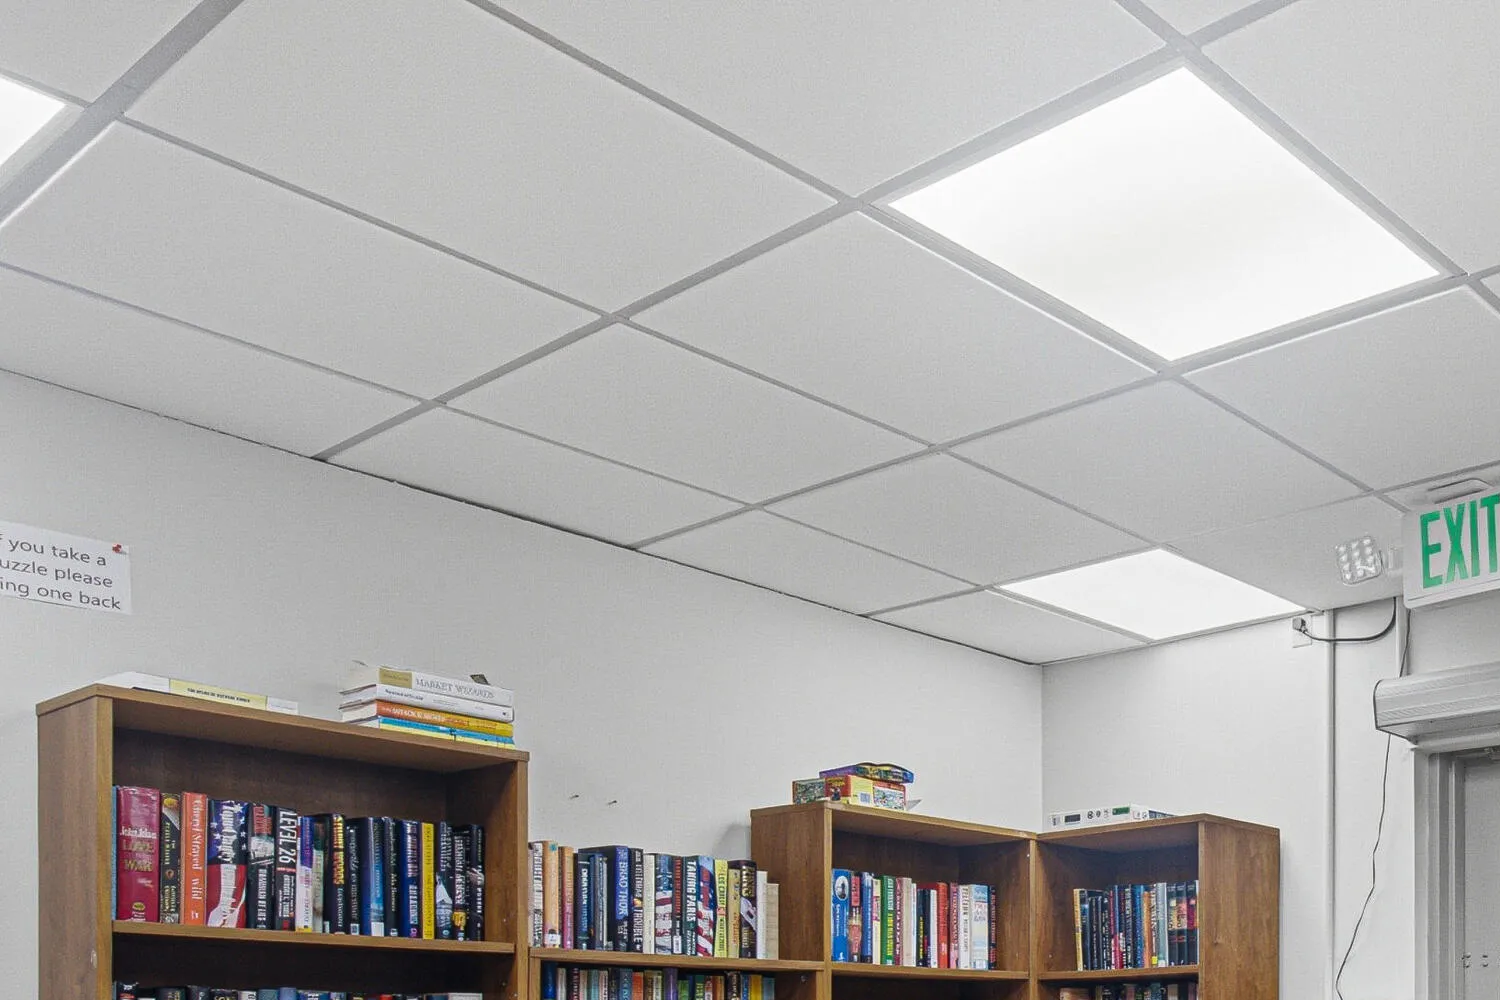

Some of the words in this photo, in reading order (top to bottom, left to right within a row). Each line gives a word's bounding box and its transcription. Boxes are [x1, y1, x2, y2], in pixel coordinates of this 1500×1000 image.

[8, 540, 44, 554] you
[52, 546, 90, 563] take
[97, 556, 106, 566] a
[1419, 493, 1500, 590] EXIT
[55, 568, 113, 587] please
[37, 587, 72, 601] one
[79, 591, 121, 609] back
[416, 677, 452, 692] MARKET
[454, 683, 495, 699] WIZARDS
[279, 811, 297, 845] LEVEL
[188, 833, 204, 870] Strayed
[279, 849, 297, 863] 26
[619, 862, 628, 887] BRAD
[687, 860, 698, 893] TAKING
[619, 890, 628, 914] THOR
[687, 896, 698, 921] PARIS
